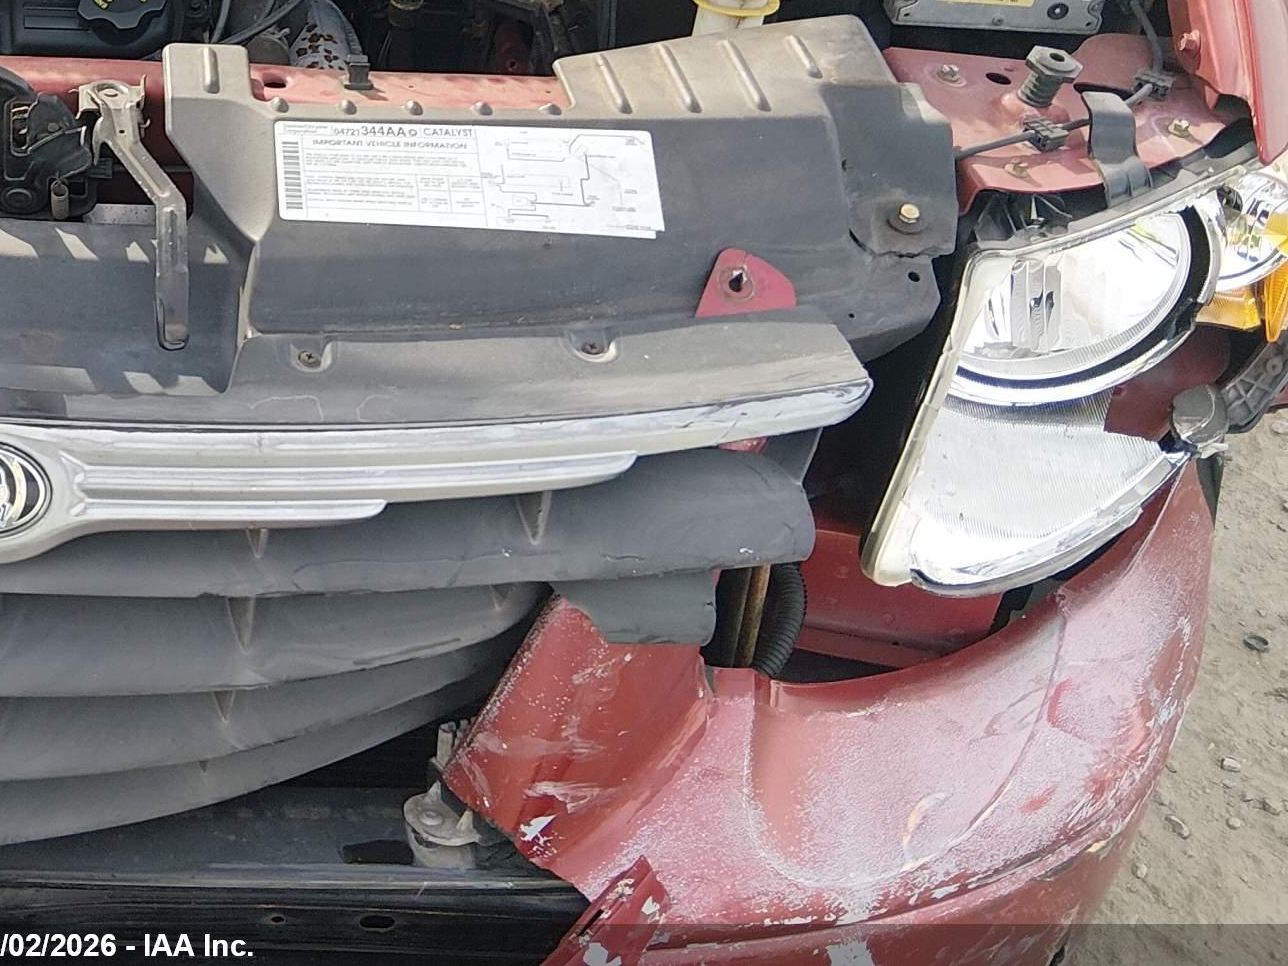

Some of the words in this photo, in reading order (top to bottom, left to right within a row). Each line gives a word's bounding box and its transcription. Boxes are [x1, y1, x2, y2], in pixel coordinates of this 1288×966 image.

[424, 127, 473, 137] CATALYST
[367, 140, 400, 148] VEHICLE
[403, 141, 467, 149] INFORMATION
